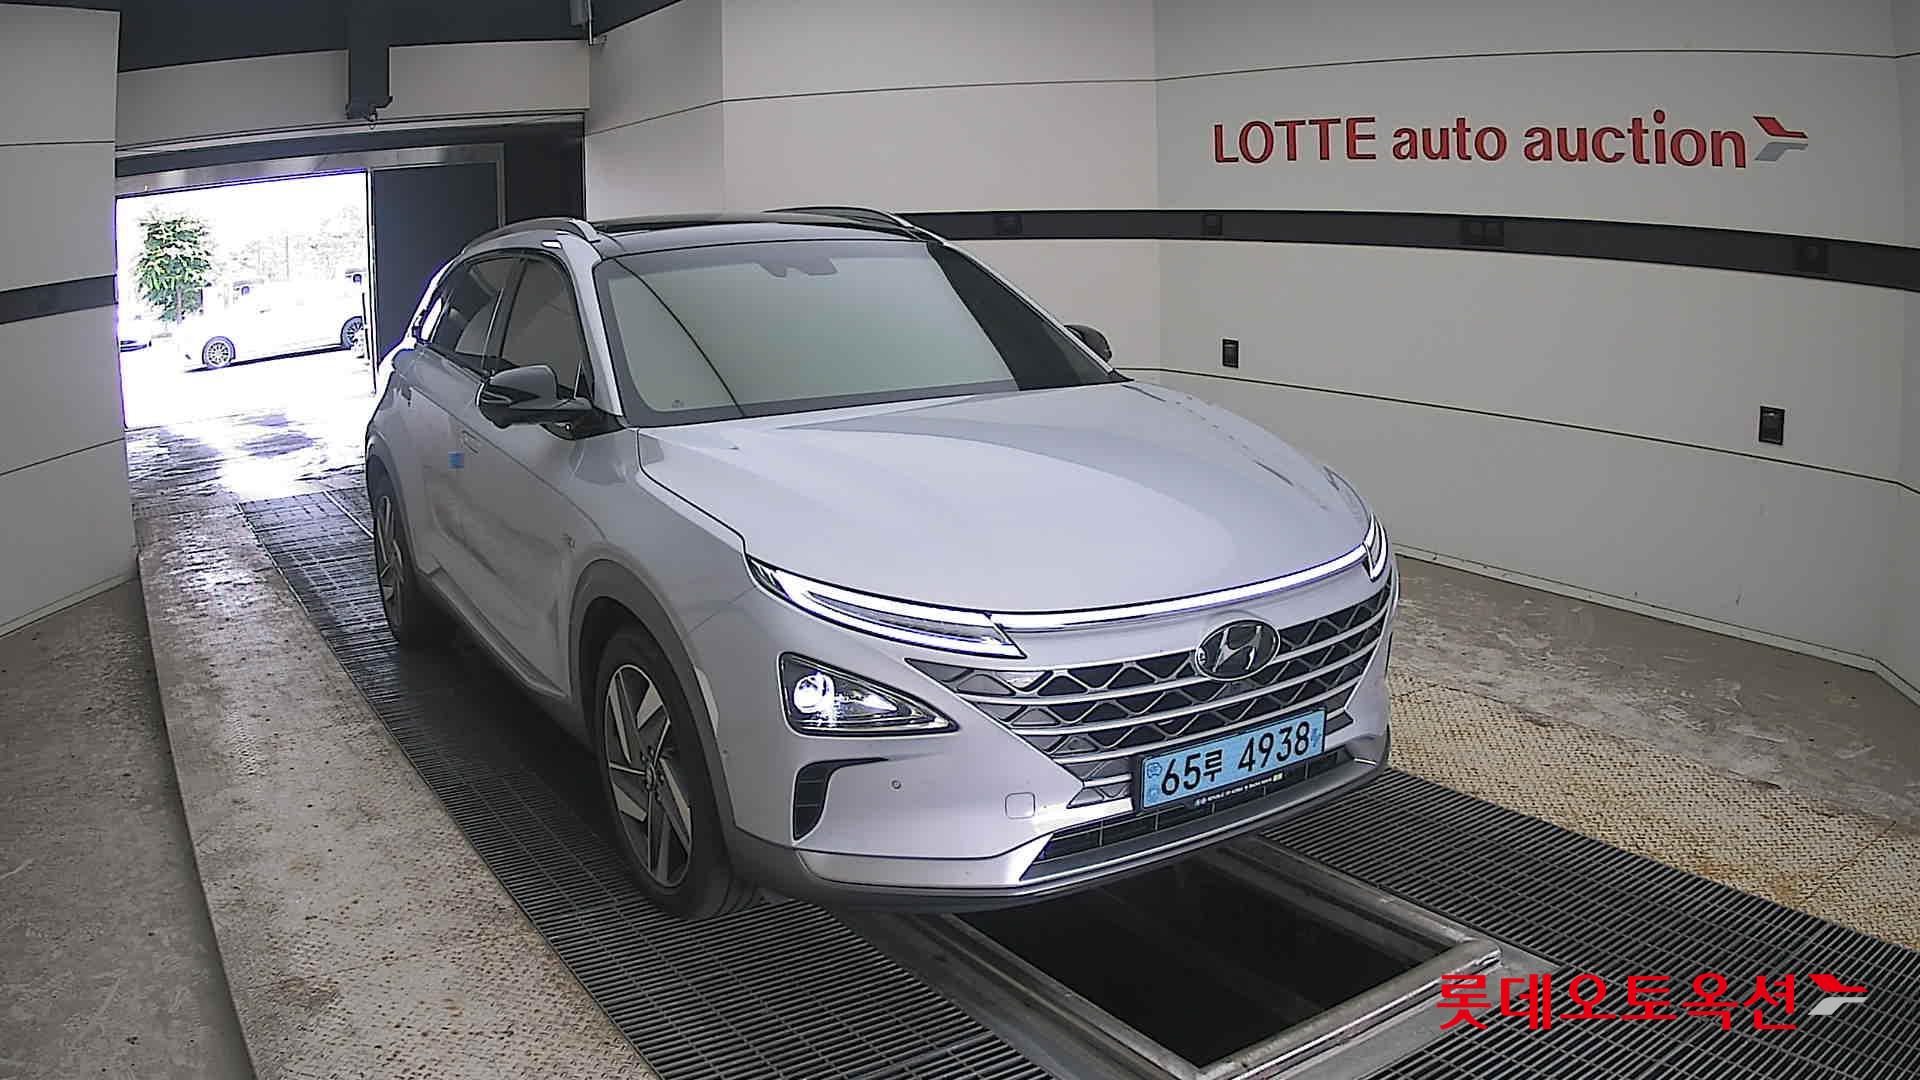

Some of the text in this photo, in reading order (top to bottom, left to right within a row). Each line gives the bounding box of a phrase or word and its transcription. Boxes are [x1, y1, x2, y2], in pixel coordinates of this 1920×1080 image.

[1214, 109, 1747, 169] LOTTE auto auction
[1161, 750, 1223, 796] 65루
[1238, 721, 1311, 772] 4938
